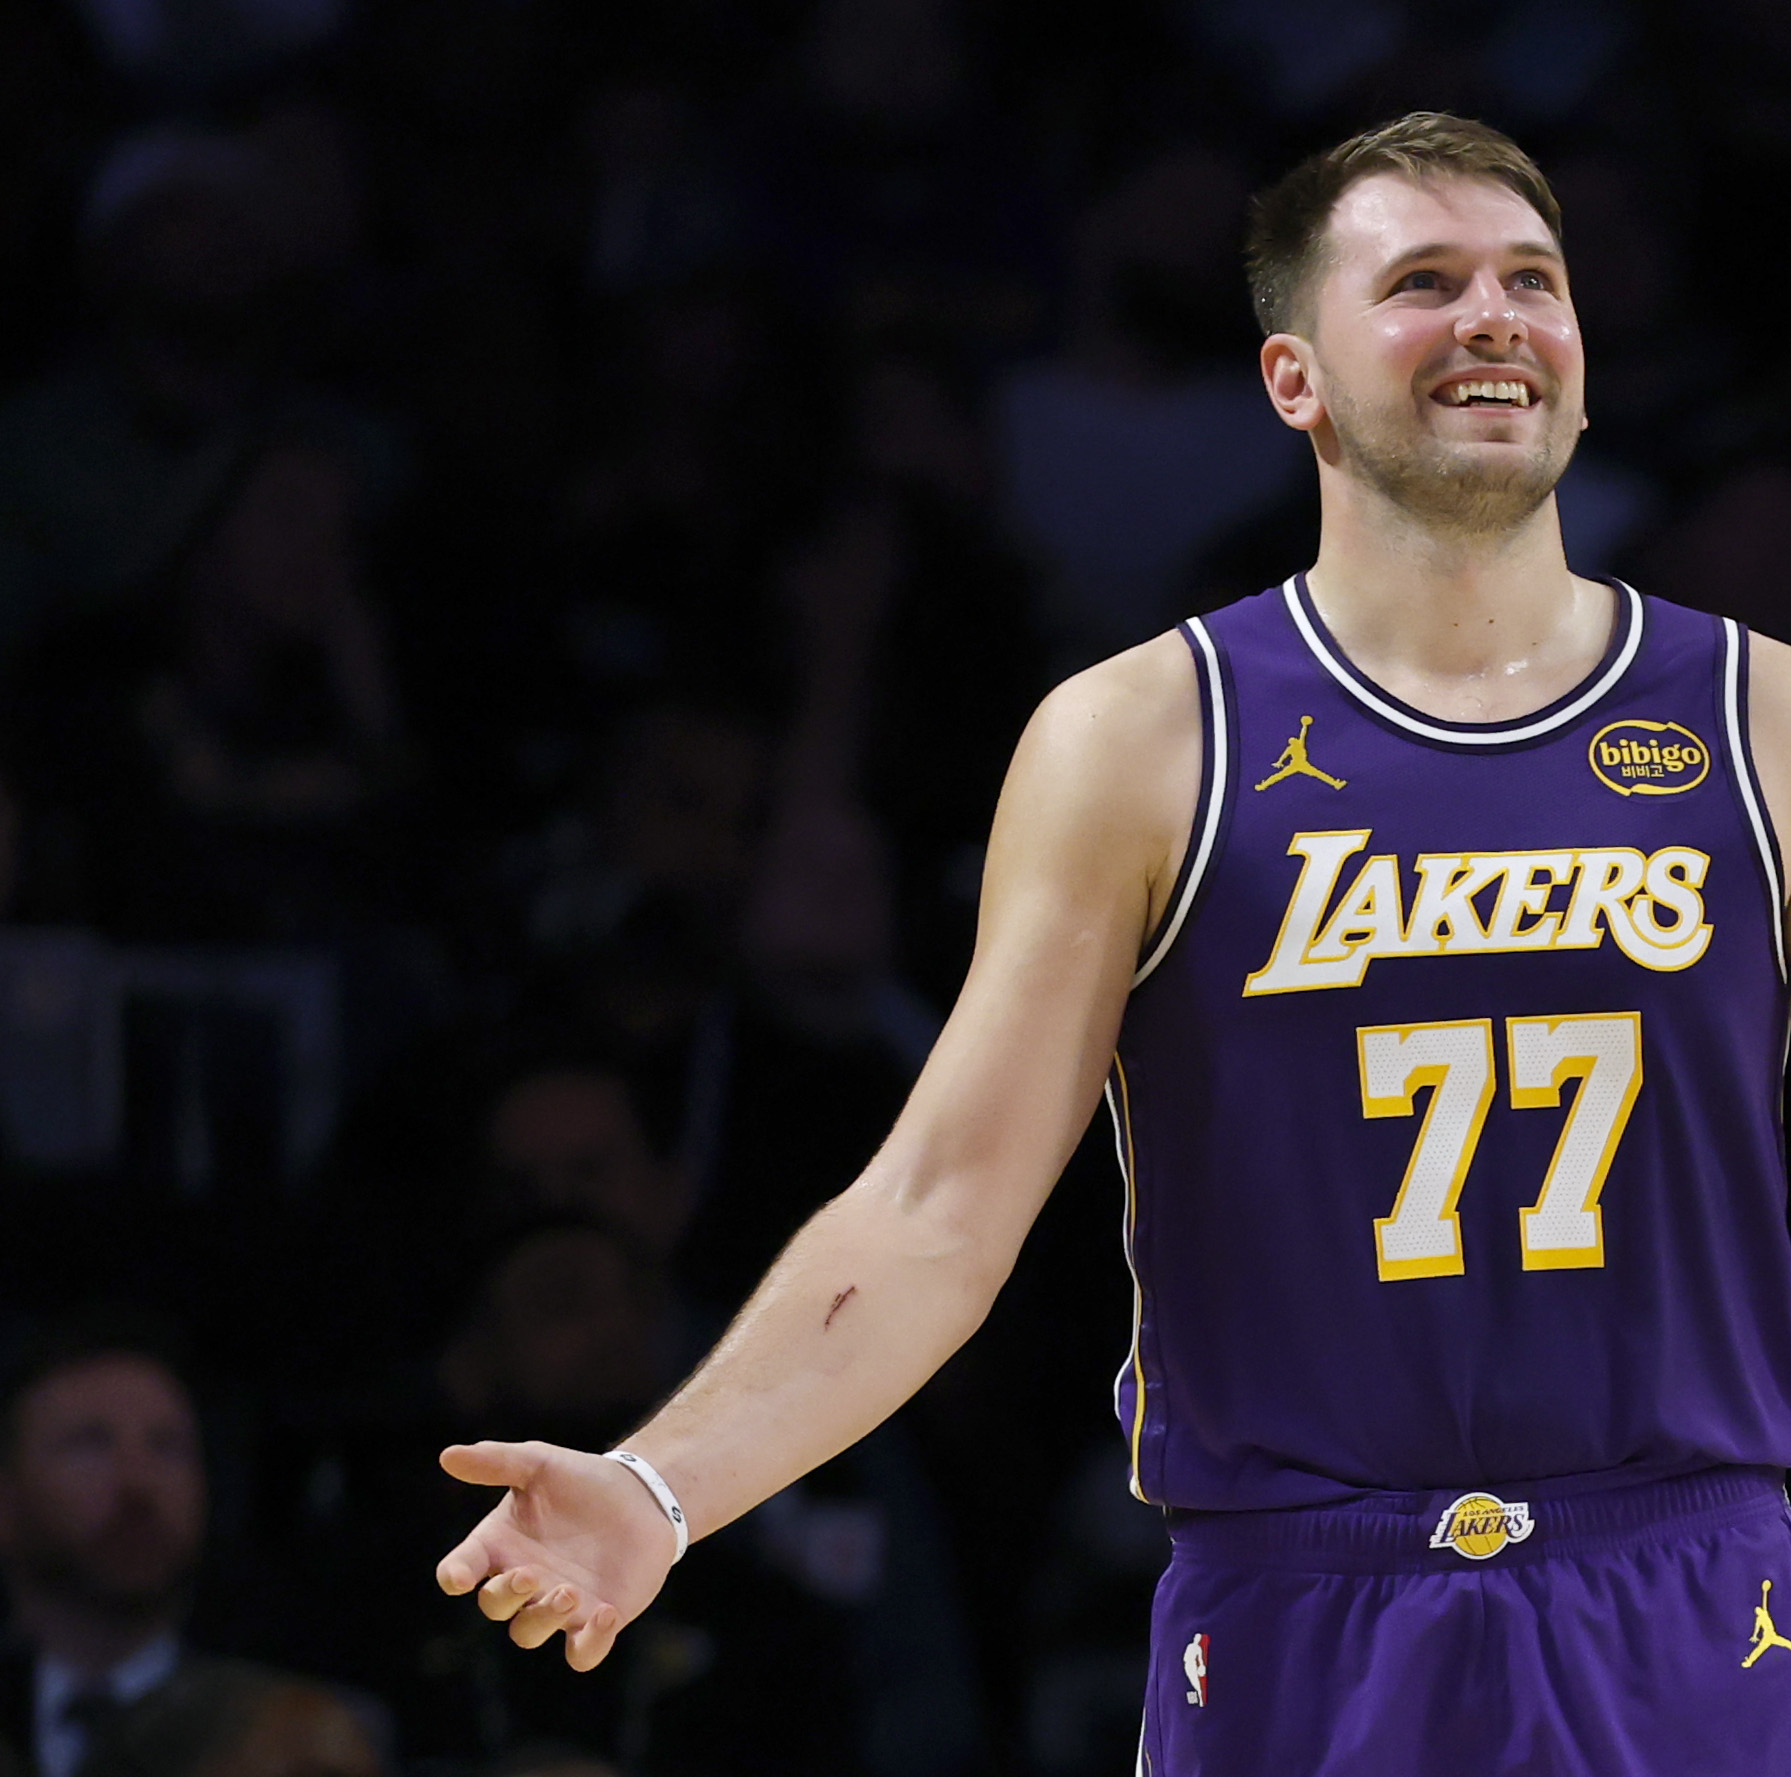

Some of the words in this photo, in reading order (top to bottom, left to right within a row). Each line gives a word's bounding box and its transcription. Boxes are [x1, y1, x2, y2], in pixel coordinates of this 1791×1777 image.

[1599, 738, 1702, 773] bibigo
[1621, 764, 1665, 779] 비비고
[1241, 828, 1714, 997] LAKERS
[1355, 1011, 1644, 1282] 77
[1436, 1512, 1525, 1543] LAKERS
[1463, 1510, 1481, 1518] LOS
[1481, 1505, 1524, 1515] ANGELES
